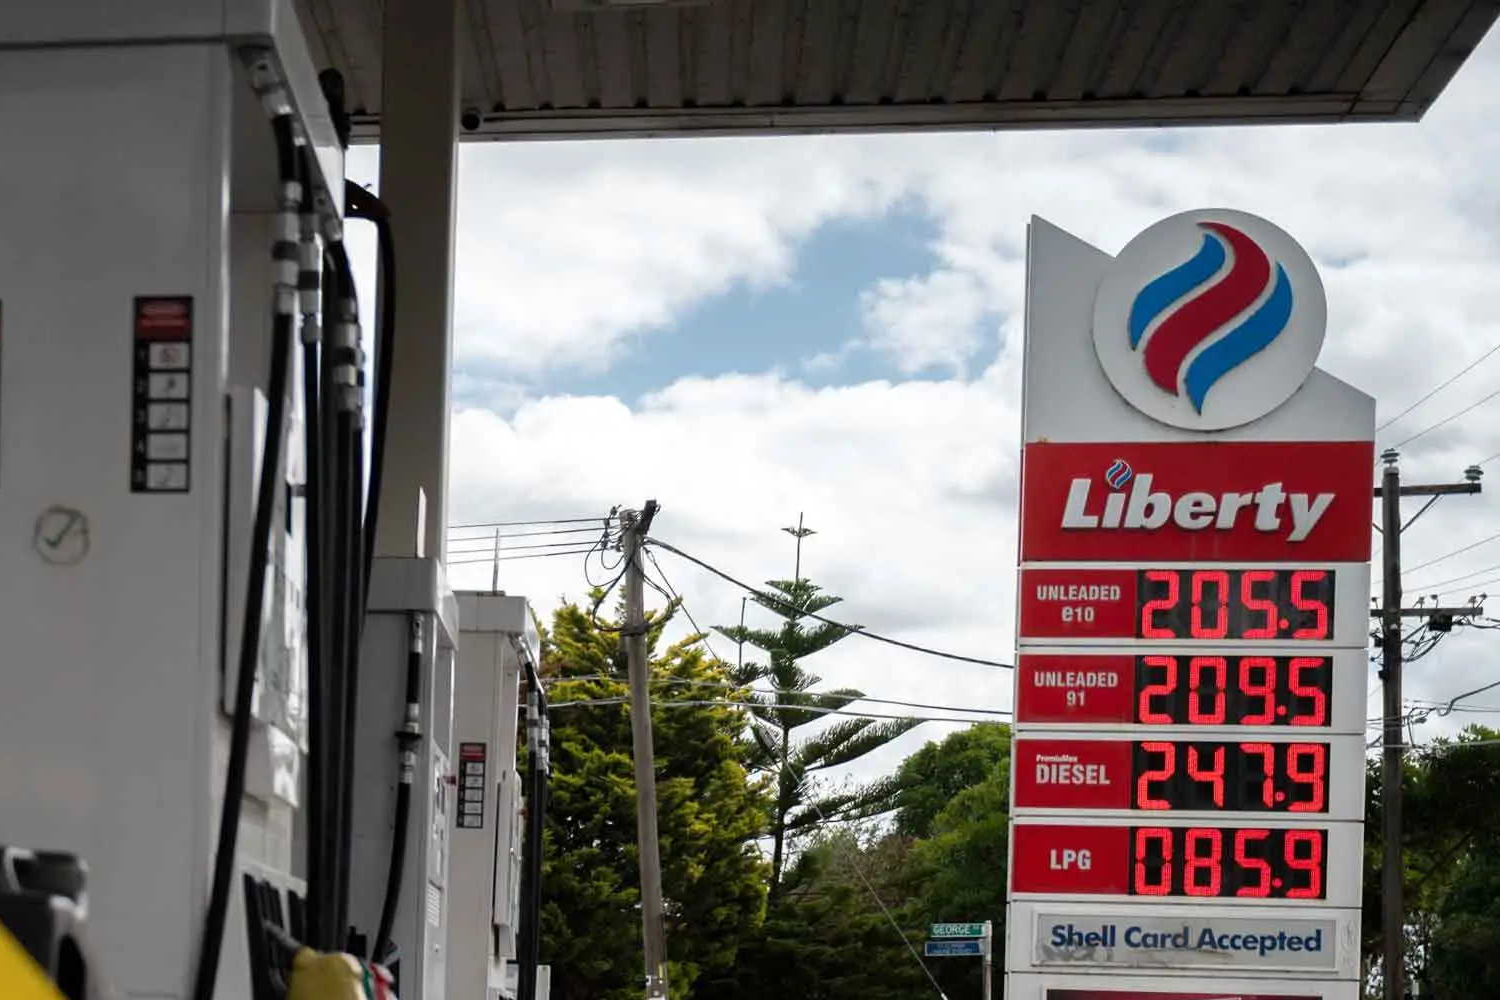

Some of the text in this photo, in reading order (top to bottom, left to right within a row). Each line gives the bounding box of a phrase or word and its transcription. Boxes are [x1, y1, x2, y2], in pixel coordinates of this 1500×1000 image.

[1060, 464, 1335, 541] Liberty
[1036, 585, 1121, 601] UNLEADED
[1141, 570, 1328, 639] 205.5
[1061, 606, 1095, 622] e10
[1034, 671, 1118, 687] UNLEADED
[1138, 655, 1325, 726] 209.5
[1066, 690, 1085, 706] 91
[1036, 764, 1111, 785] DIESEL
[1136, 742, 1325, 813] 247.9
[1050, 849, 1092, 871] LPG
[1134, 827, 1322, 898] 085.9
[1050, 924, 1322, 957] Shell Card Accepted
